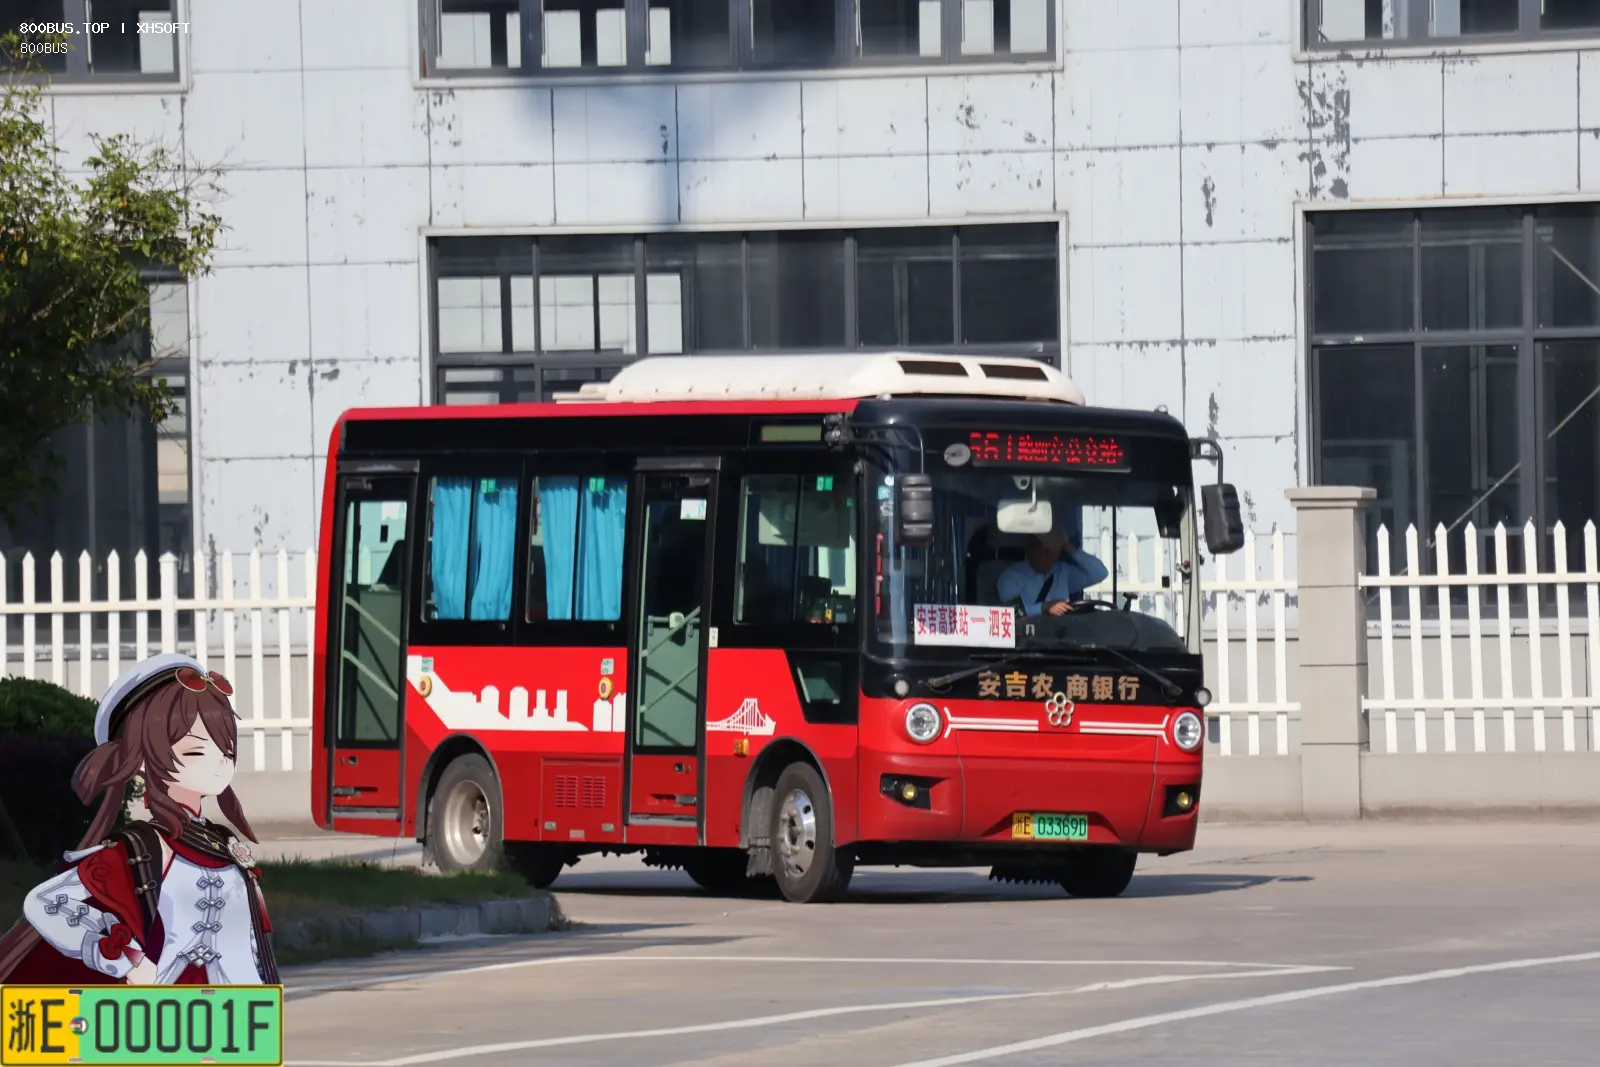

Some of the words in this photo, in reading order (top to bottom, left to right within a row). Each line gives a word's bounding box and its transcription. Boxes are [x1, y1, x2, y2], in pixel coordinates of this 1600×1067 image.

[917, 604, 969, 637] 安吉高铁站
[989, 608, 1012, 639] 泗安
[978, 671, 1141, 701] 安吉农商银行
